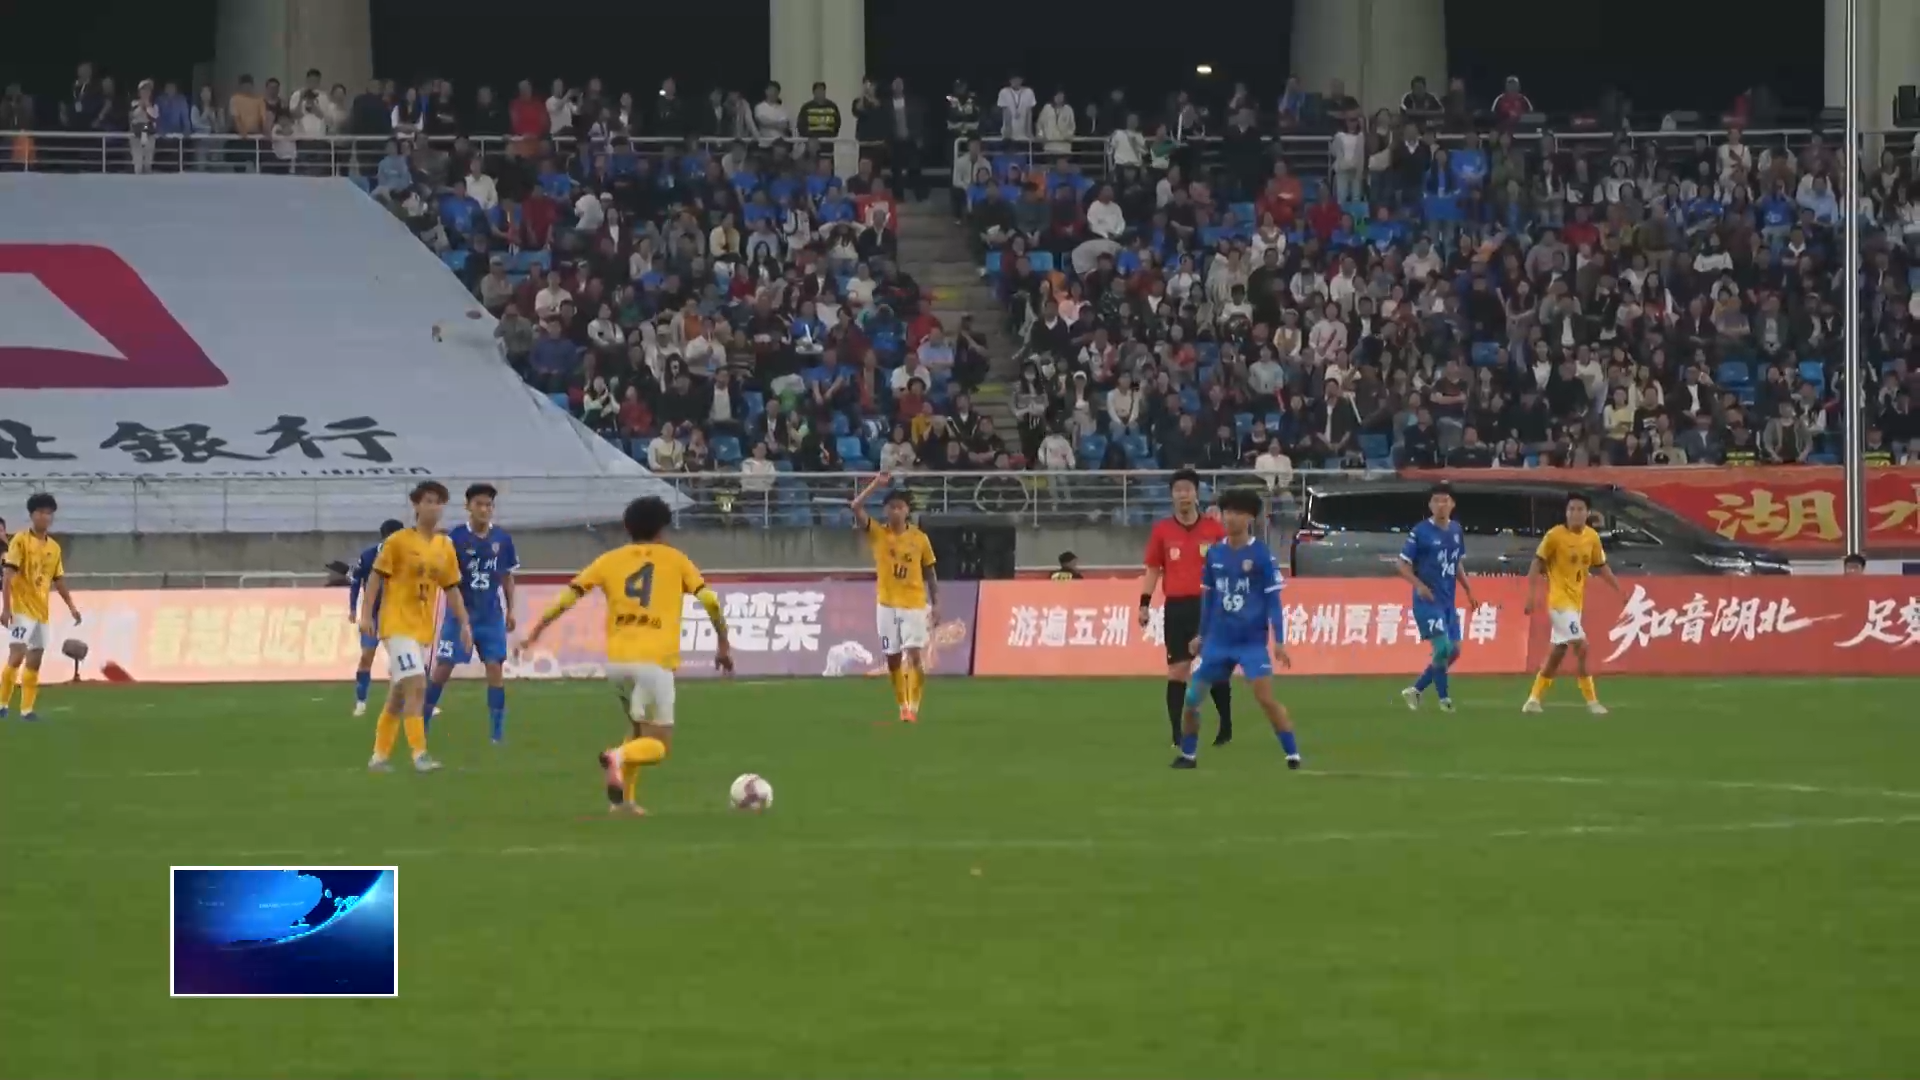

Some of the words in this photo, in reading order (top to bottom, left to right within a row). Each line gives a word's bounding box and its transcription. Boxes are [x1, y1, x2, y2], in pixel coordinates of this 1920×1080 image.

[469, 573, 490, 589] 25
[624, 561, 655, 608] 4
[1223, 594, 1245, 612] 69
[1007, 605, 1131, 646] 游遍五洲
[1280, 602, 1499, 645] 徐州贾青串
[1428, 618, 1445, 632] 74
[1568, 621, 1579, 635] 6
[1602, 584, 1843, 663] 知音湖北
[11, 626, 27, 640] 47
[437, 640, 453, 657] 25
[881, 636, 890, 649] 0
[397, 653, 417, 671] 11
